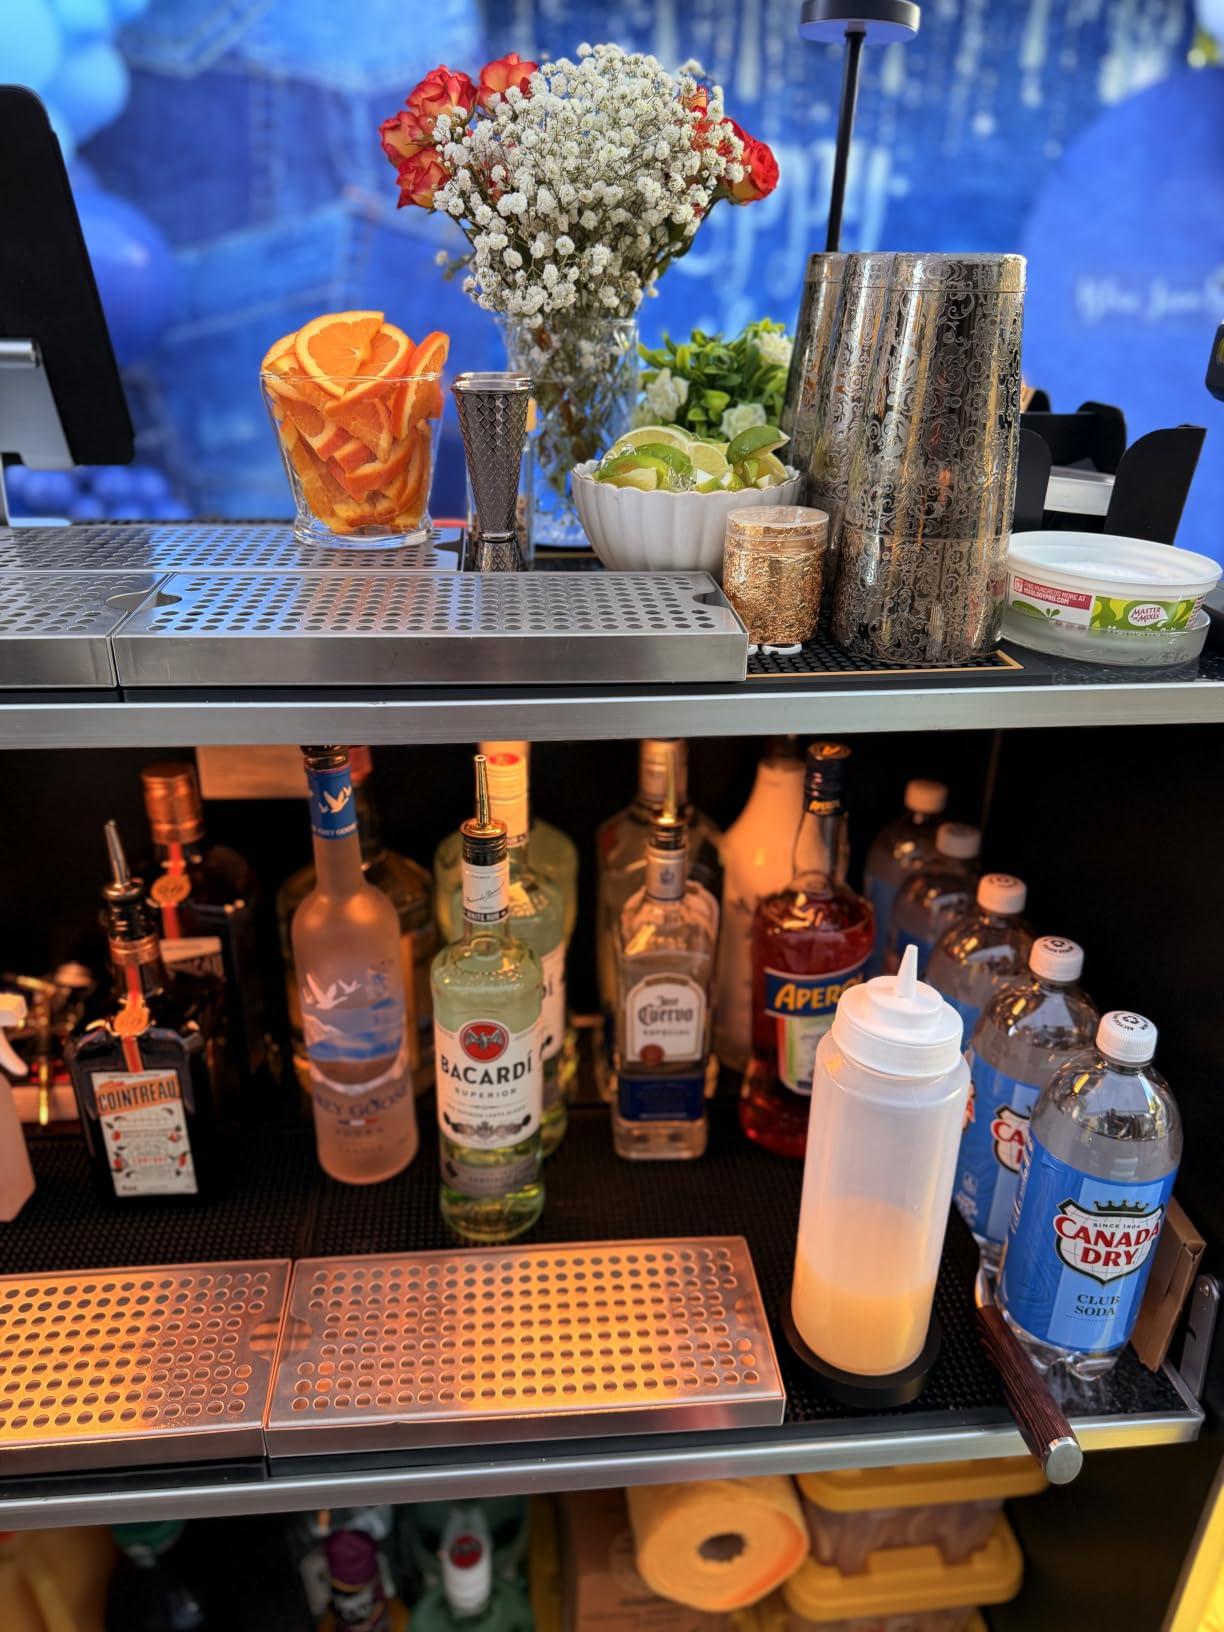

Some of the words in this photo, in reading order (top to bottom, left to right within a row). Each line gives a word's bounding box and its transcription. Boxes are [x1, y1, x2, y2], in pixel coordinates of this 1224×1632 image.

[1023, 587, 1070, 605] MIXOLOGYPRO.COM
[1062, 592, 1078, 600] MORE
[1131, 607, 1161, 618] MASTER
[1137, 612, 1160, 622] MIXES
[638, 1003, 694, 1026] Cuervo
[441, 1049, 533, 1086] BACARDÍ
[99, 1079, 178, 1111] COINTREAU
[455, 1086, 518, 1099] SUPERIOR
[1055, 1215, 1160, 1249] CANADA
[1080, 1246, 1139, 1267] DRY
[1077, 1294, 1120, 1306] CLUB
[1074, 1305, 1115, 1317] SODA
